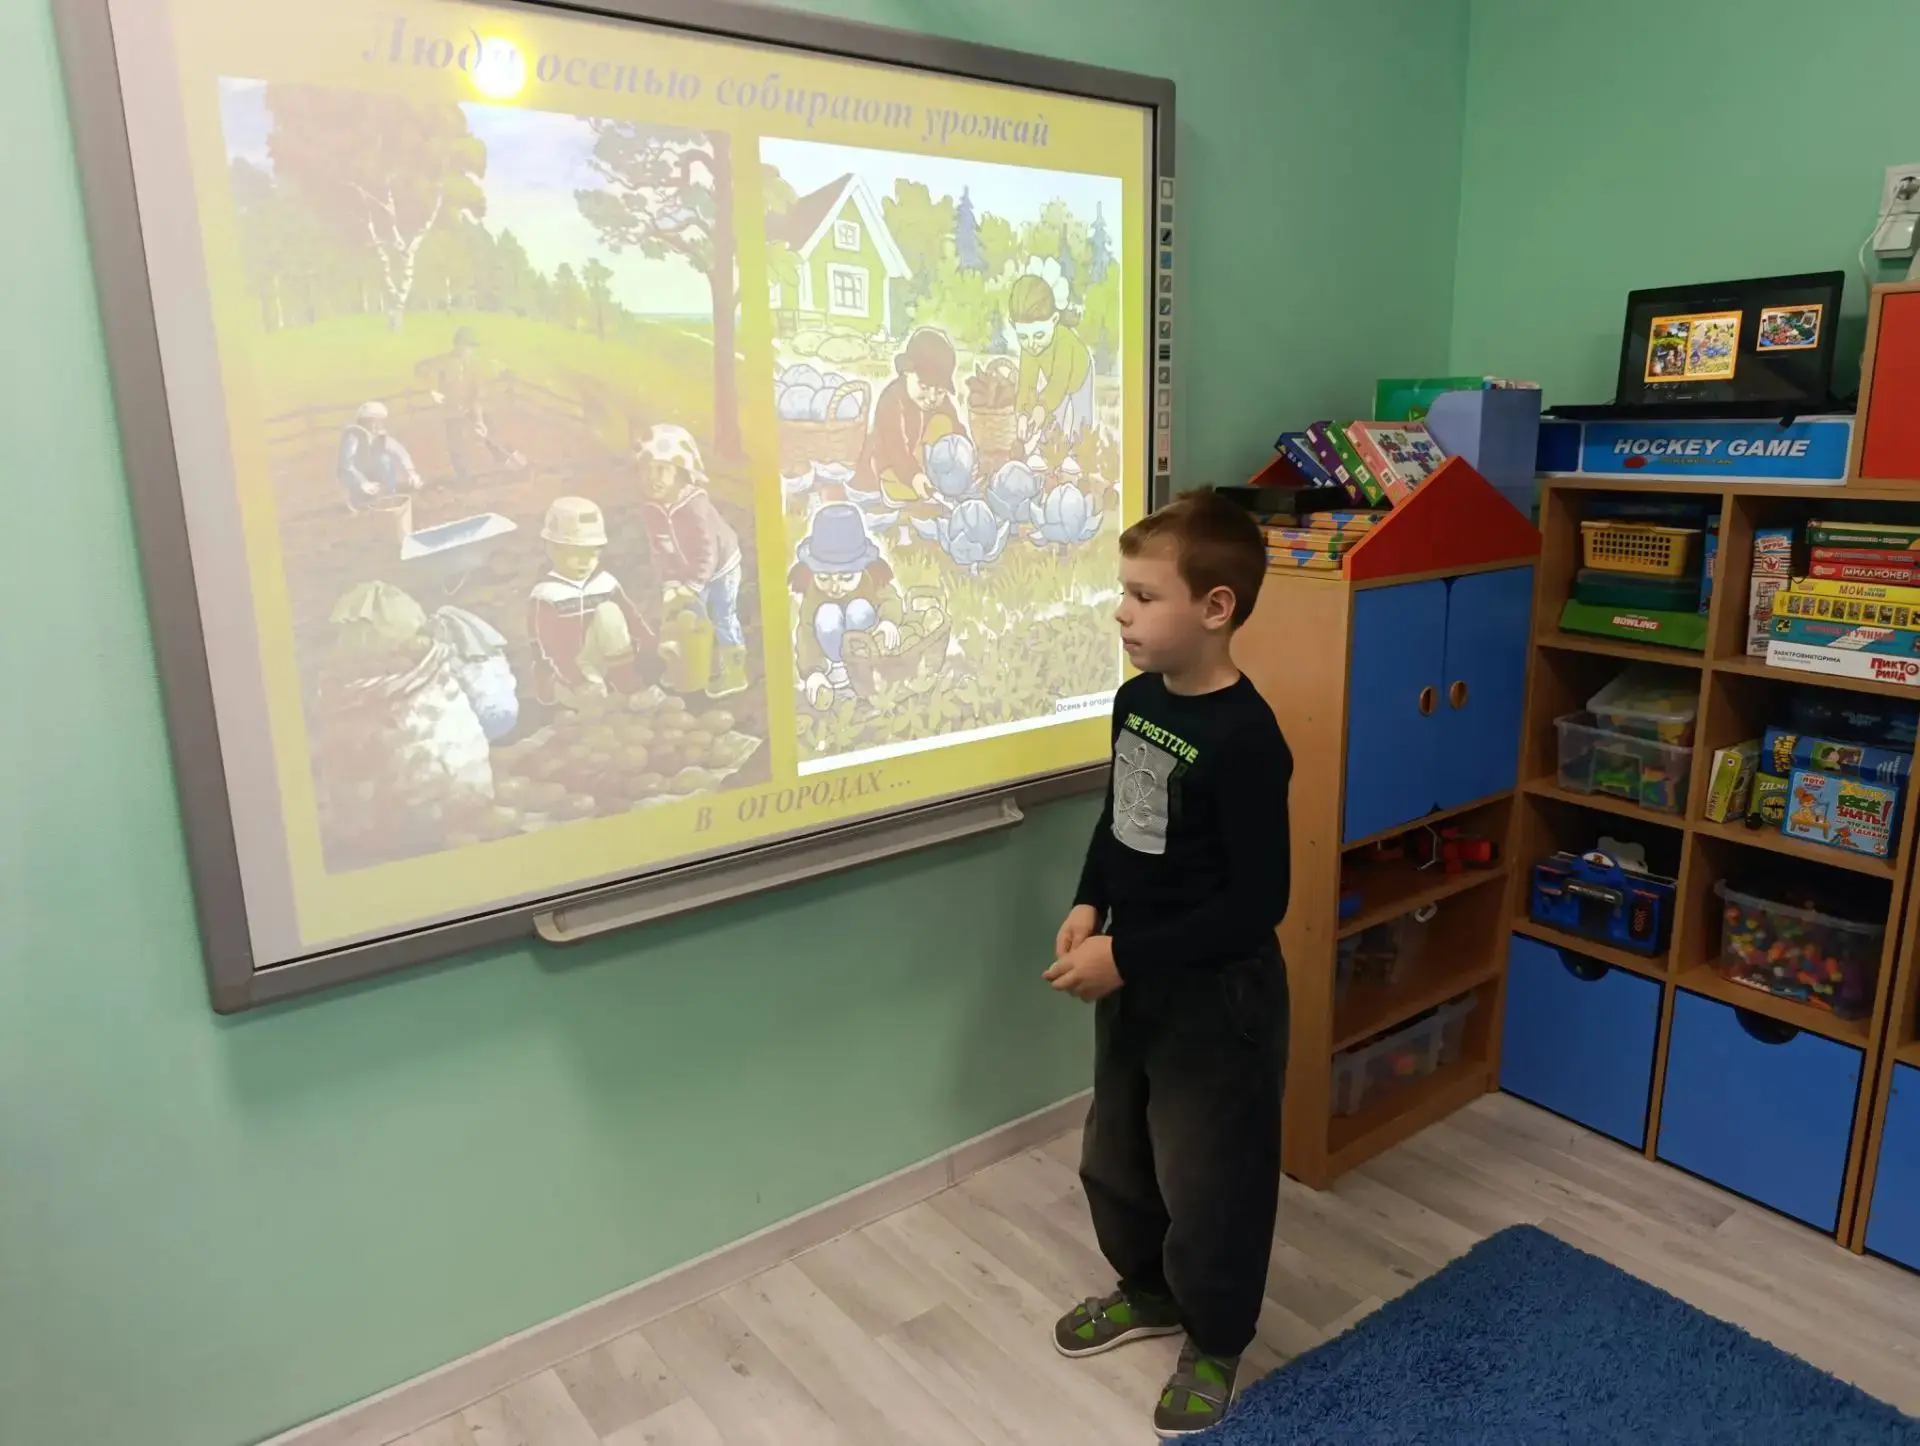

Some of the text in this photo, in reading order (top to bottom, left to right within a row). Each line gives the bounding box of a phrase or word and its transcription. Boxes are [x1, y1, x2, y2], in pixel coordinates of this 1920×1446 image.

[537, 51, 702, 101] осенью
[716, 72, 914, 129] собирают
[921, 105, 1050, 147] урожай
[1613, 438, 1811, 457] HOCKEY GAME
[1844, 566, 1910, 580] МИЛЛИОНЕР
[1612, 615, 1658, 630] BOWLING
[1056, 702, 1081, 713] Осень
[1124, 713, 1199, 764] THE POSITIVE
[694, 806, 713, 833] В
